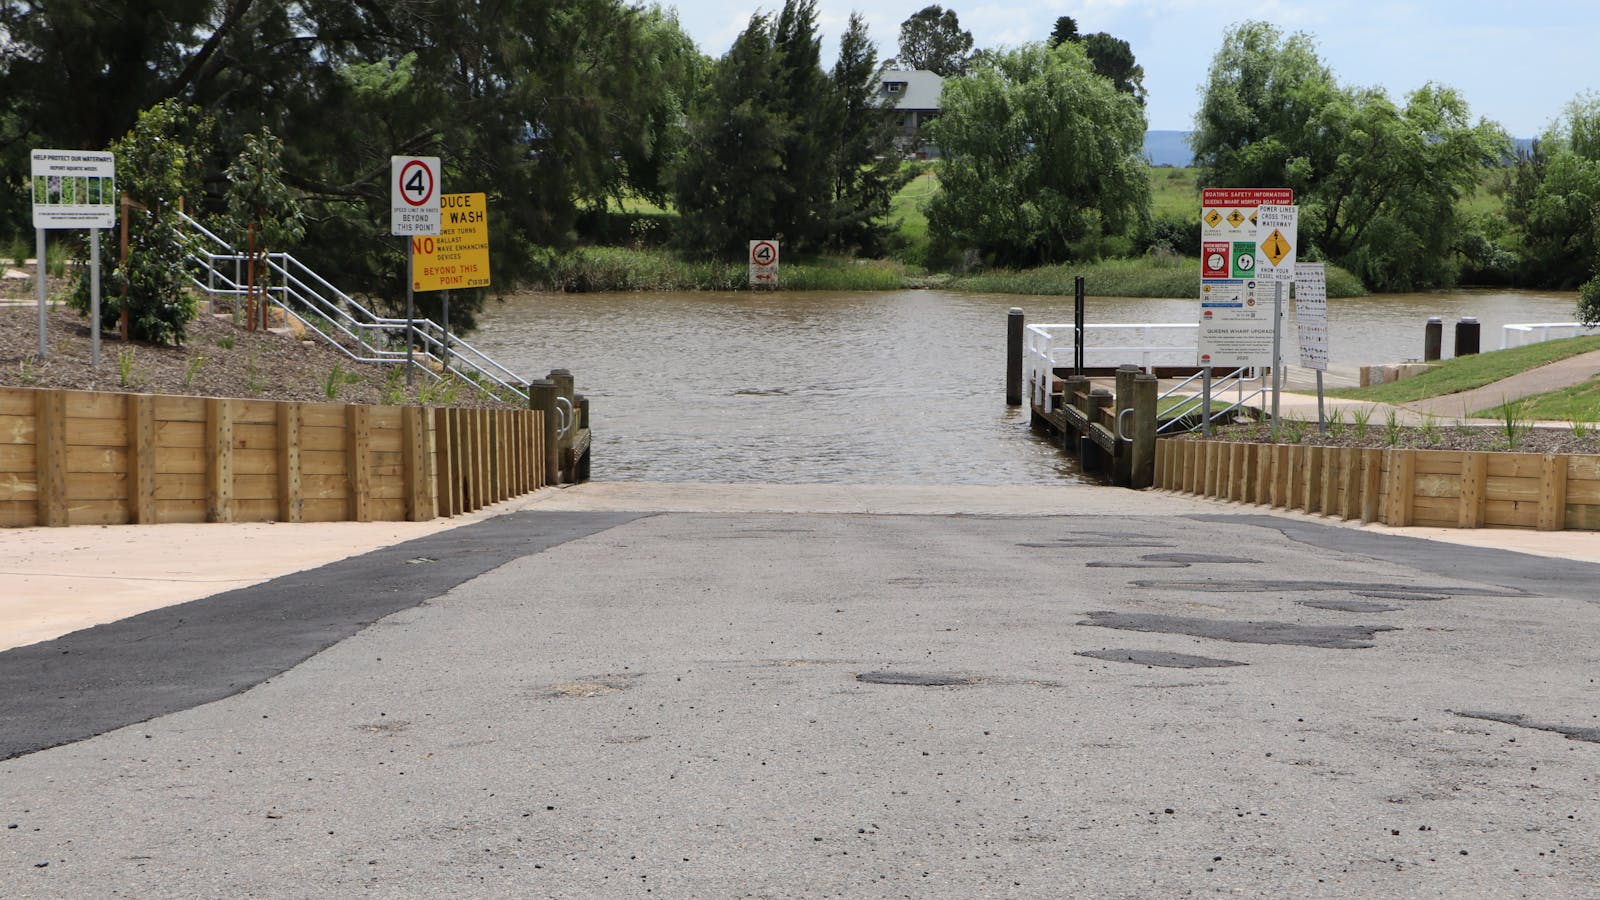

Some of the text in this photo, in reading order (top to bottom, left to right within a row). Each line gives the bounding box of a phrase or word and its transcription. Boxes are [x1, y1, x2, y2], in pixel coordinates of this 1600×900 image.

[406, 169, 424, 196] 4
[441, 196, 470, 208] DUCE
[451, 211, 483, 223] WASH
[412, 238, 434, 255] NO
[758, 247, 770, 260] 4
[424, 264, 478, 276] BEYOND THIS
[440, 276, 463, 285] POINT
